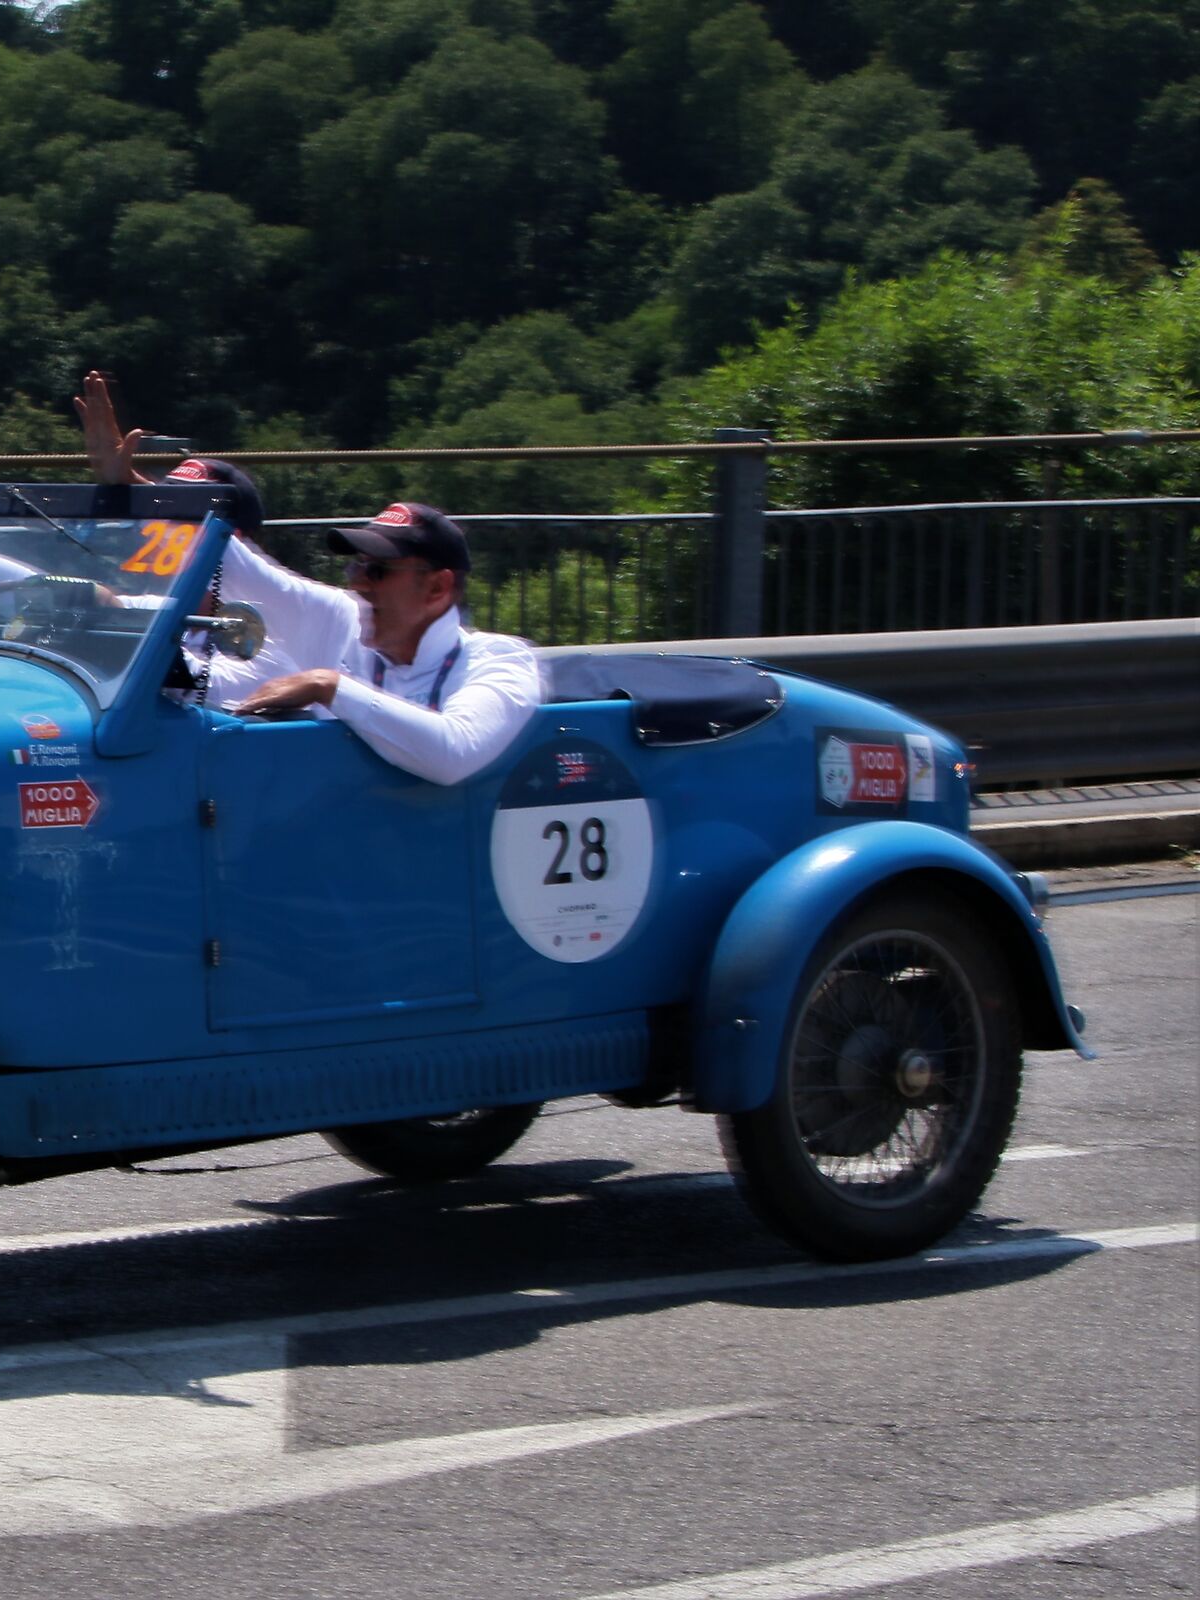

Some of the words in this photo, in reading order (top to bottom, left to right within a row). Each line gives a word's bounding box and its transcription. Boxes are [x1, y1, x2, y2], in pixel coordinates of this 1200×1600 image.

[120, 521, 196, 576] 28
[861, 751, 895, 770] 1000
[26, 786, 77, 802] 1000
[857, 779, 897, 797] MIGLIA
[25, 806, 82, 824] MIGLIA
[542, 817, 609, 885] 28
